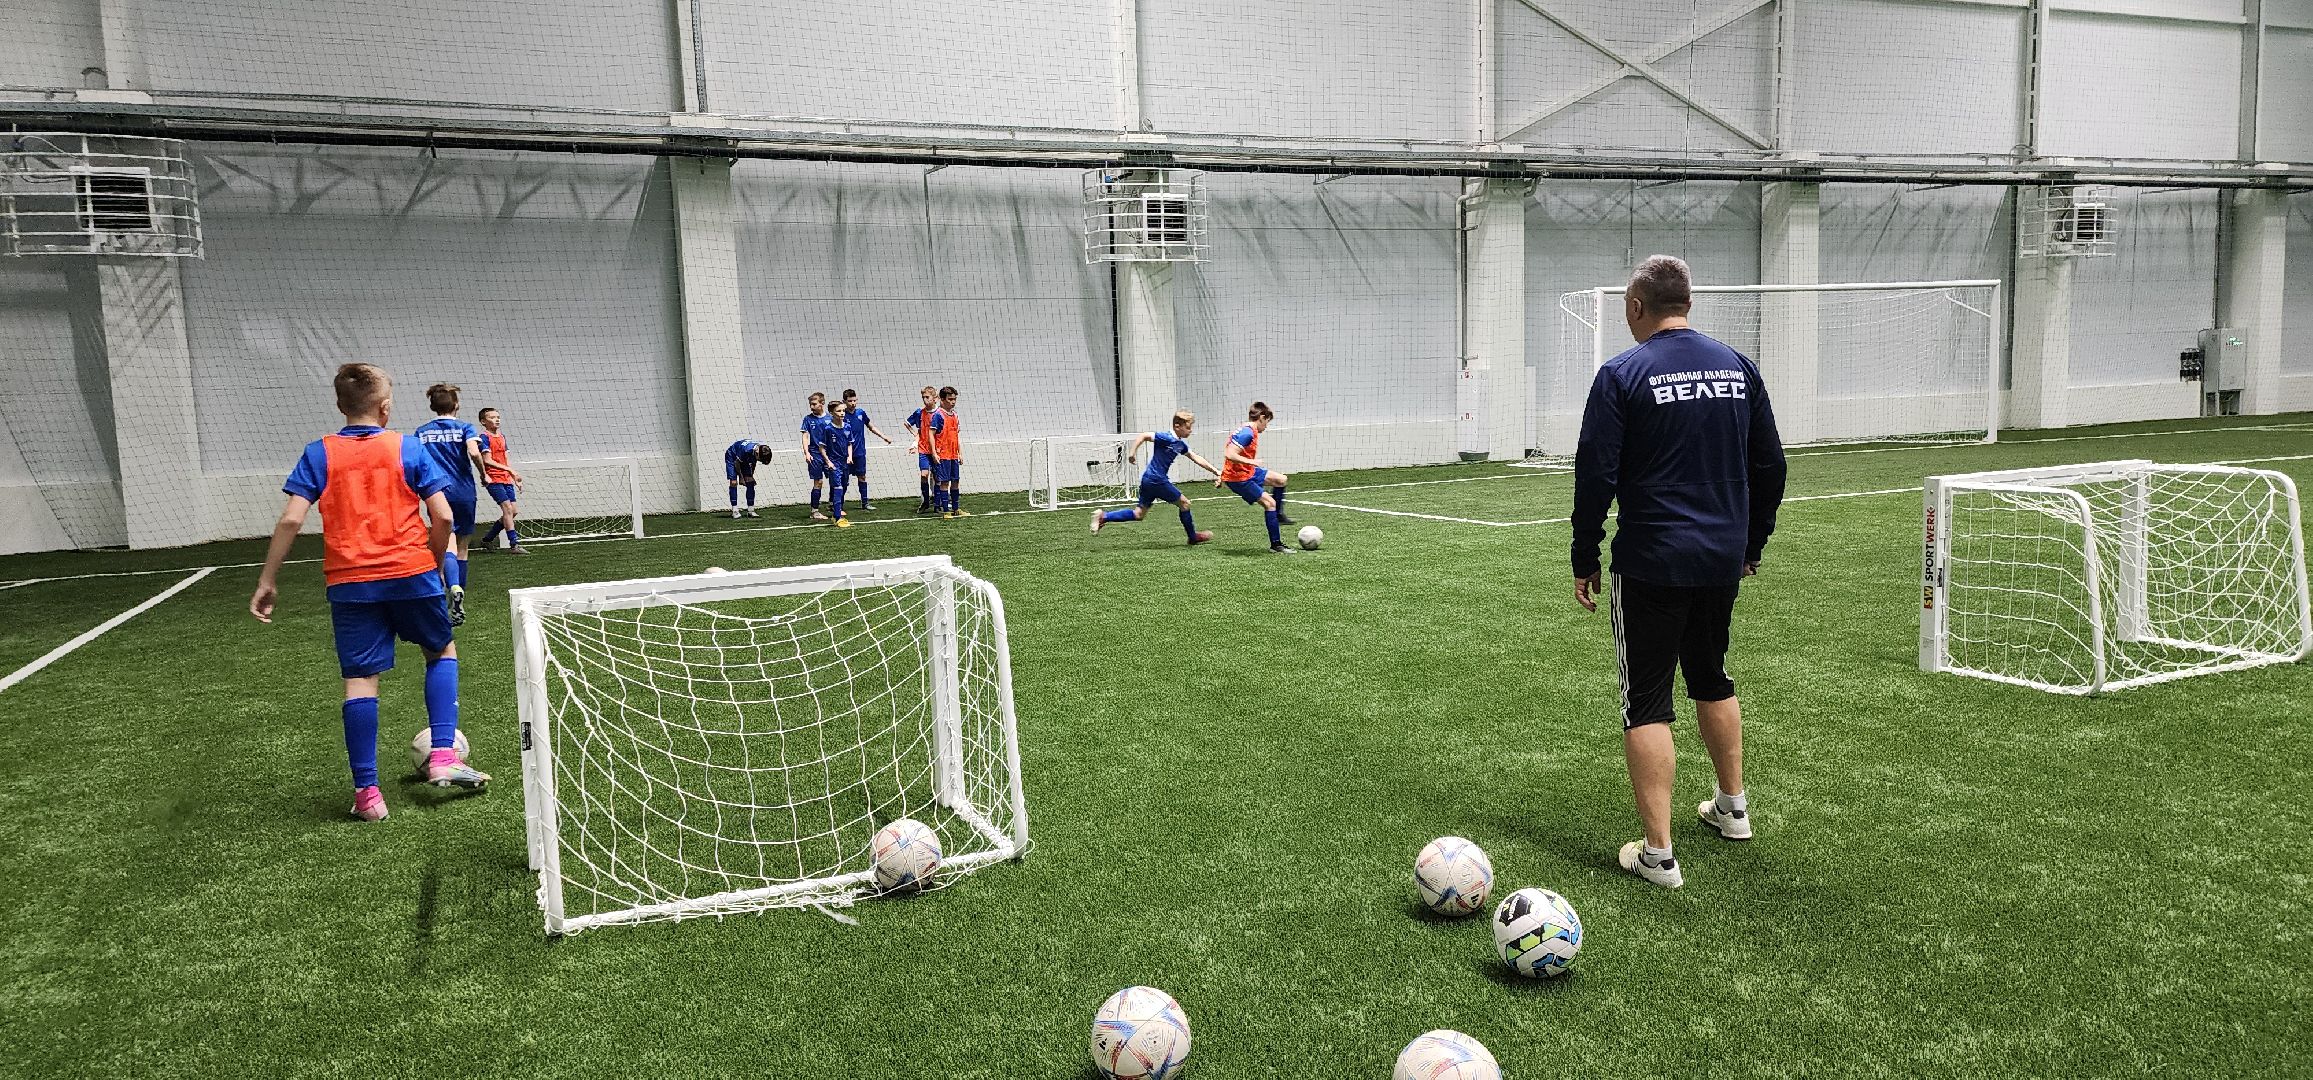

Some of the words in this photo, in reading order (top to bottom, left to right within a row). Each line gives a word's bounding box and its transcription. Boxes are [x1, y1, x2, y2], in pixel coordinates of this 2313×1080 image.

[1649, 371, 1702, 386] ФУТБОЛЬНАЯ
[1704, 370, 1745, 382] АКАДЕМИЯ
[1652, 381, 1746, 405] ВЕЛЕС
